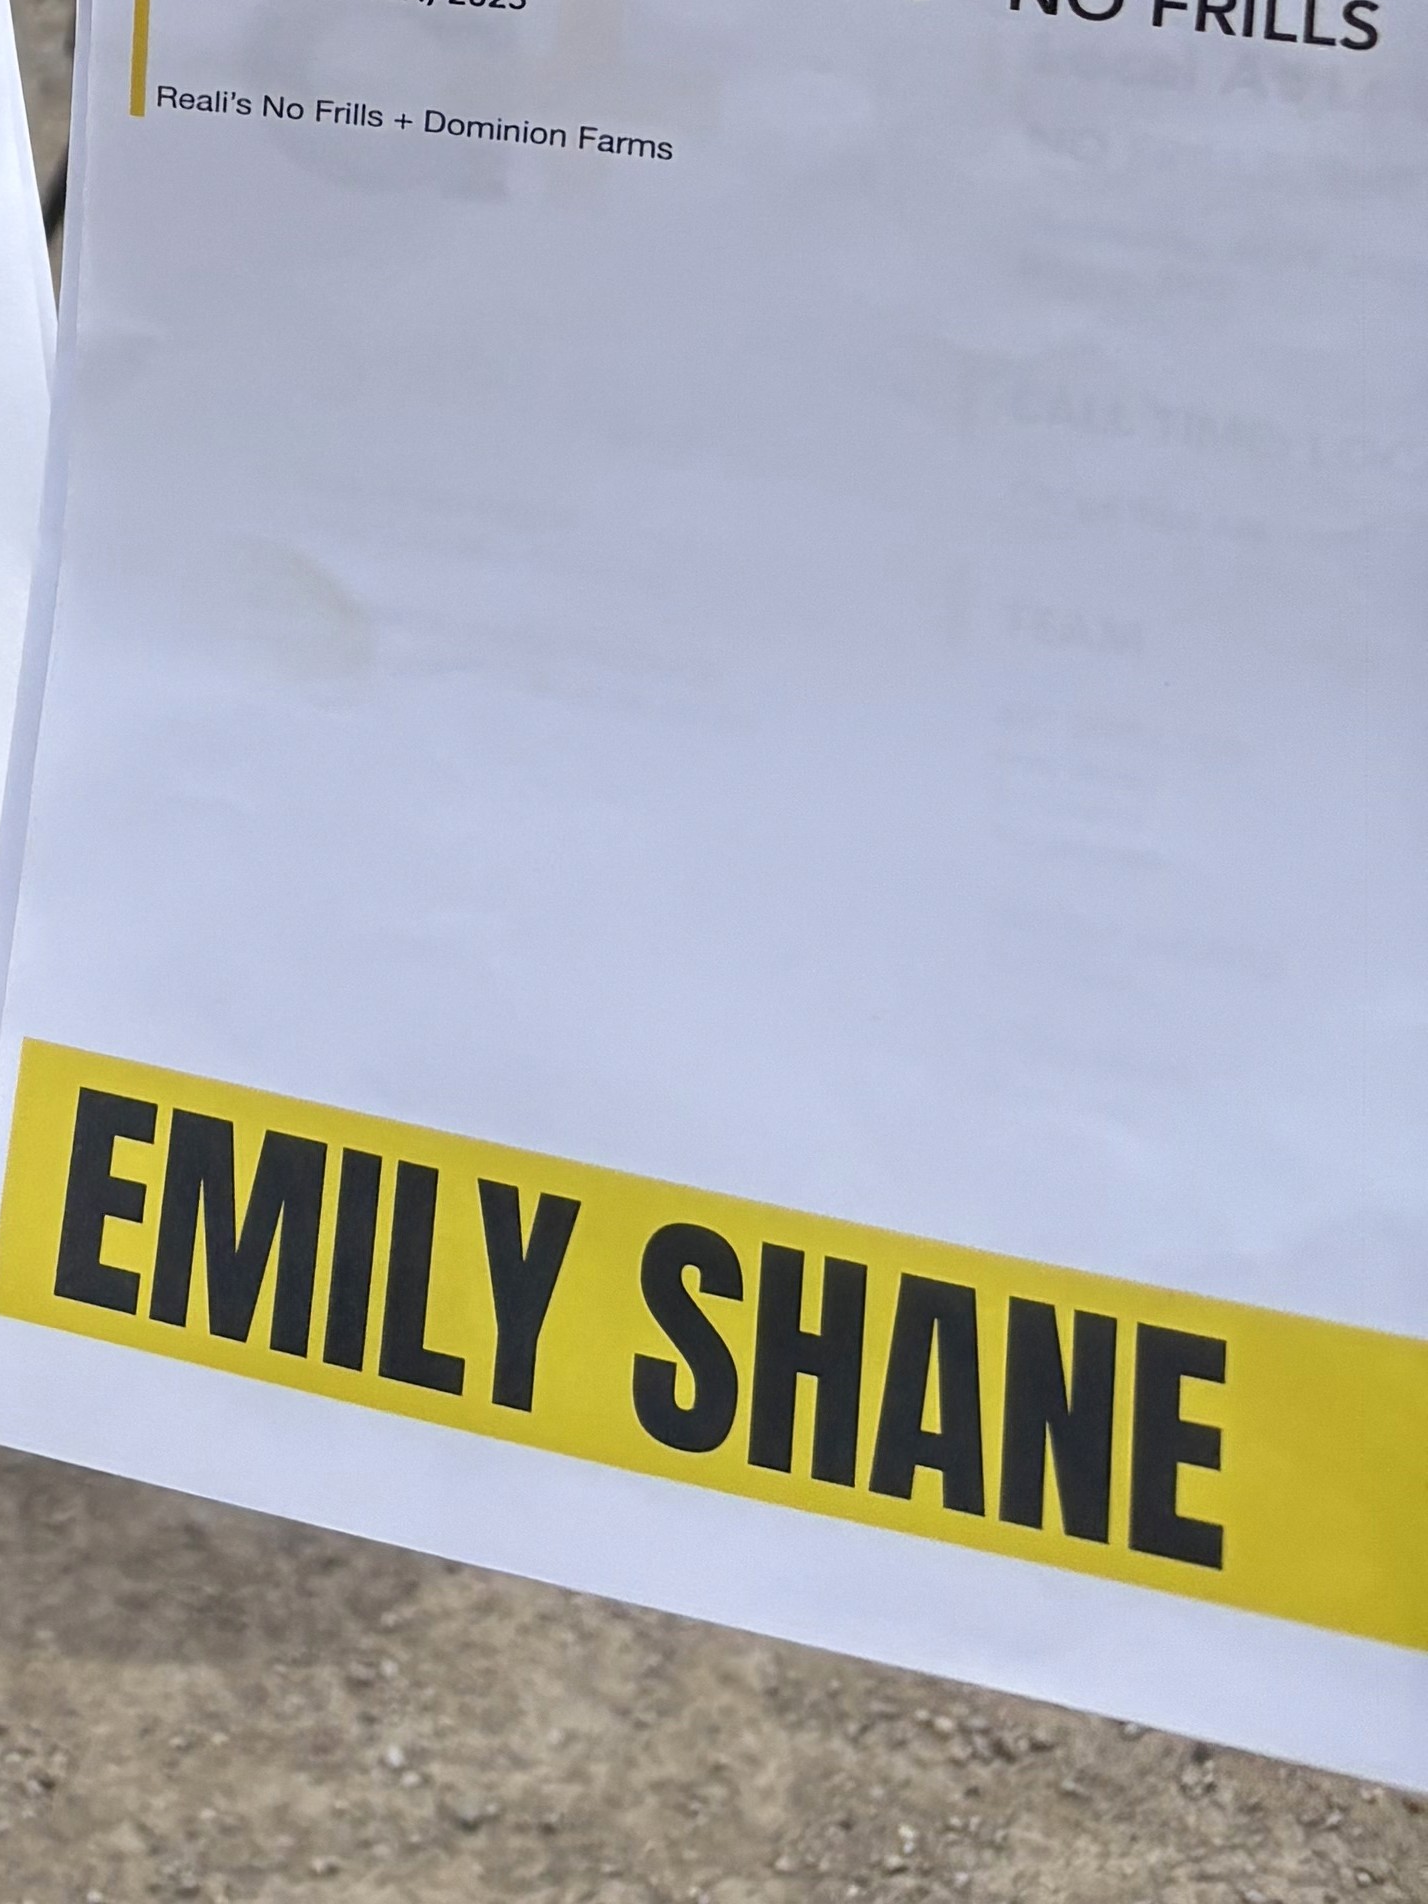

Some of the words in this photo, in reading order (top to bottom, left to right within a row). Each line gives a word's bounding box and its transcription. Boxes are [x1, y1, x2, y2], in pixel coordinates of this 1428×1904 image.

[157, 85, 252, 116] Reali’s
[262, 94, 305, 120] No
[315, 99, 383, 128] Frills
[394, 113, 413, 130] +
[424, 109, 567, 148] Dominion
[578, 125, 673, 161] Farms
[53, 1086, 582, 1413] EMILY
[632, 1222, 1227, 1571] SHANE
